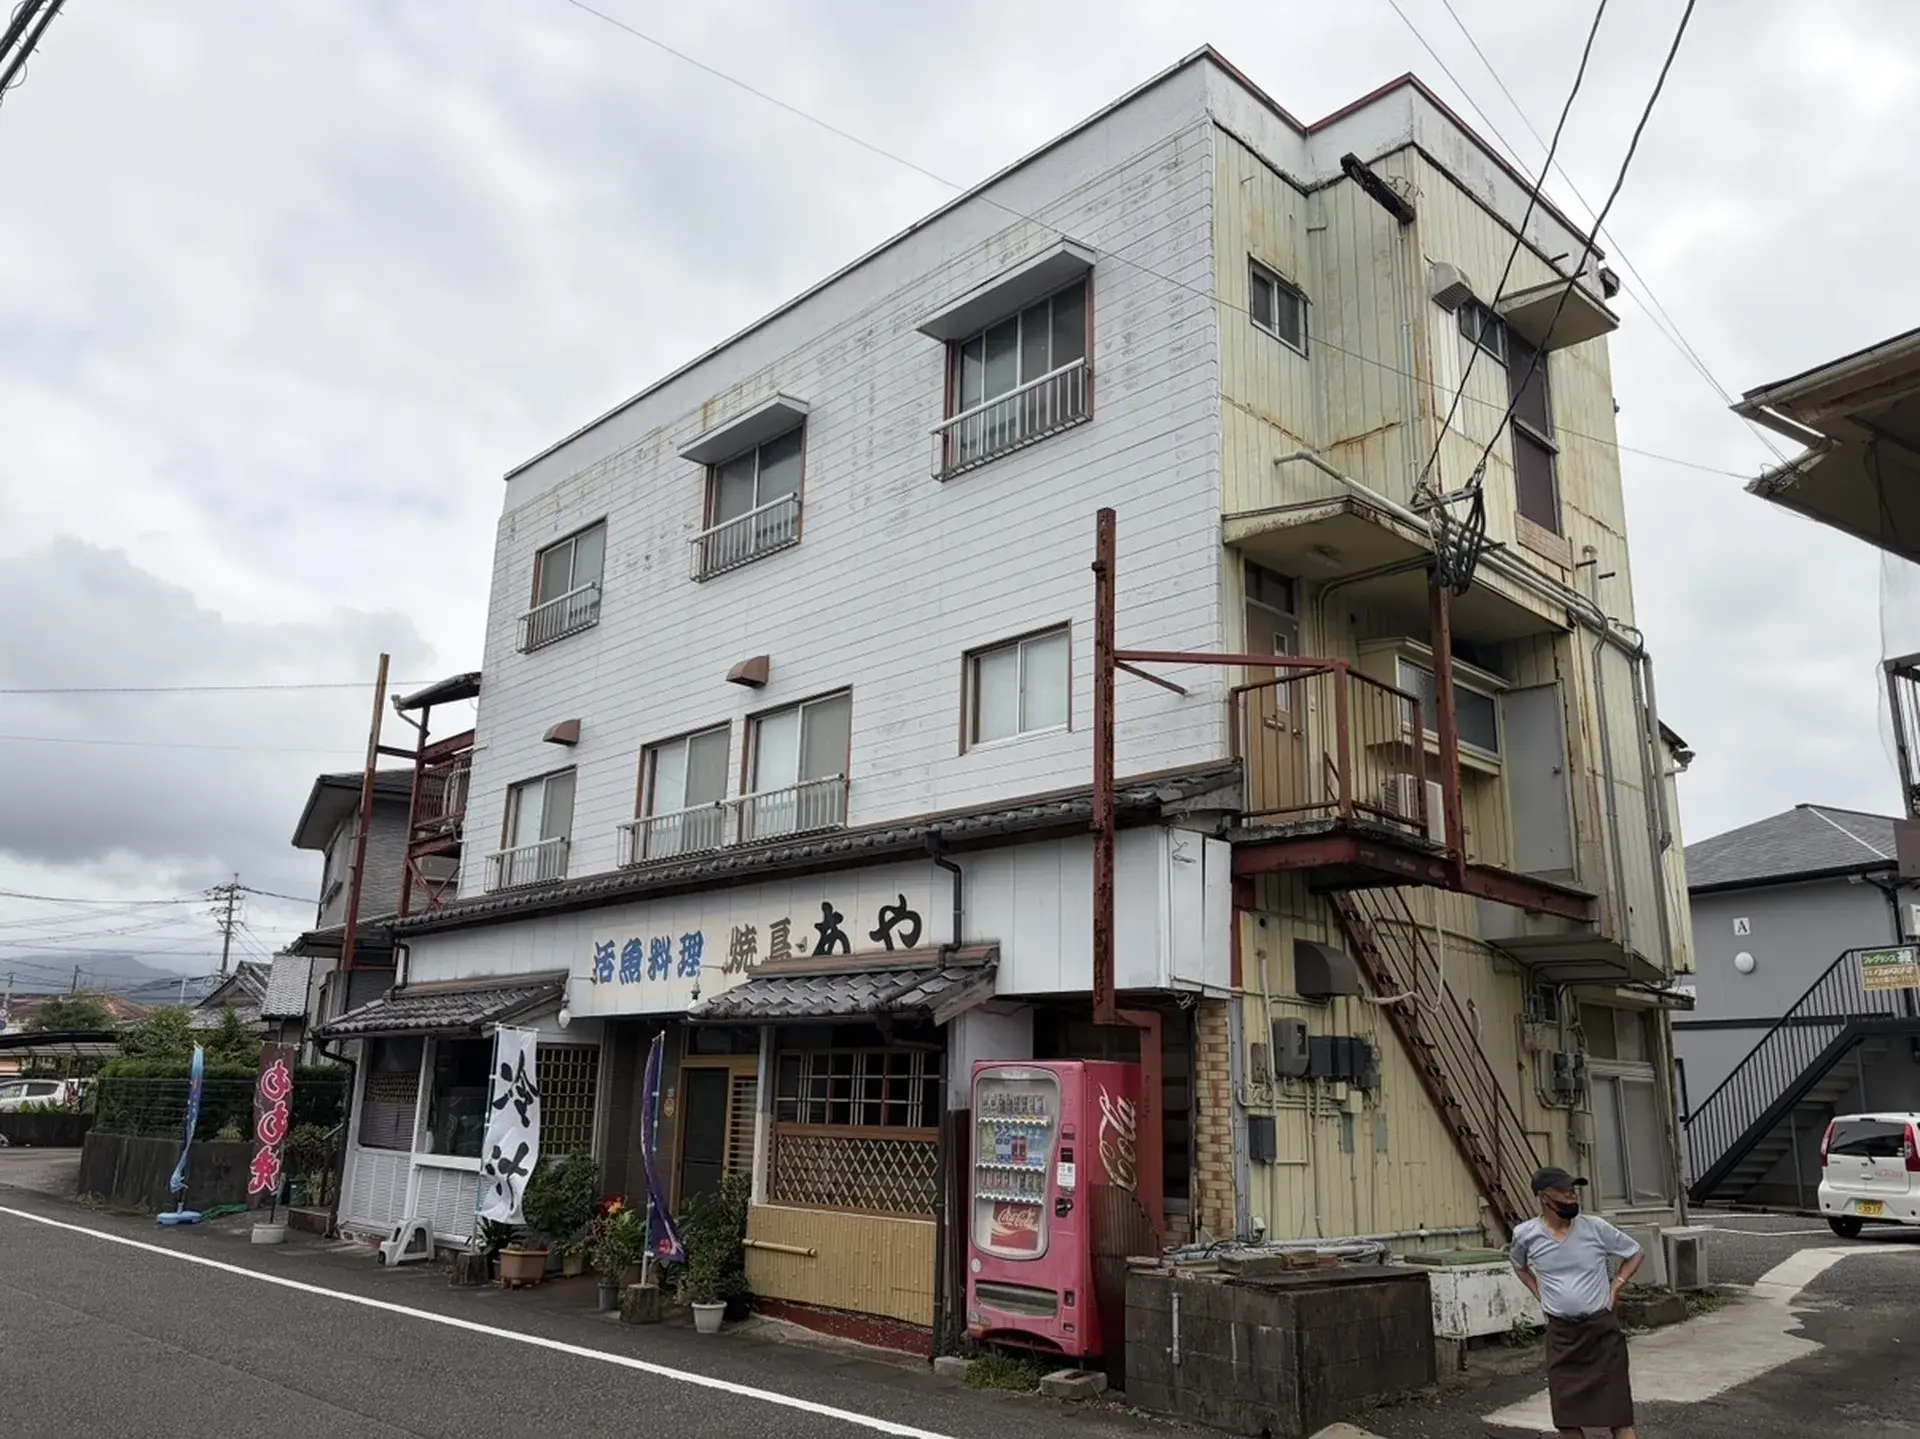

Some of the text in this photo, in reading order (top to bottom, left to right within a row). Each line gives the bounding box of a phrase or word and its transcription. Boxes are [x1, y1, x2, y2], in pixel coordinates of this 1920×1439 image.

[1737, 919, 1748, 933] A
[591, 930, 703, 985] 活魚料理
